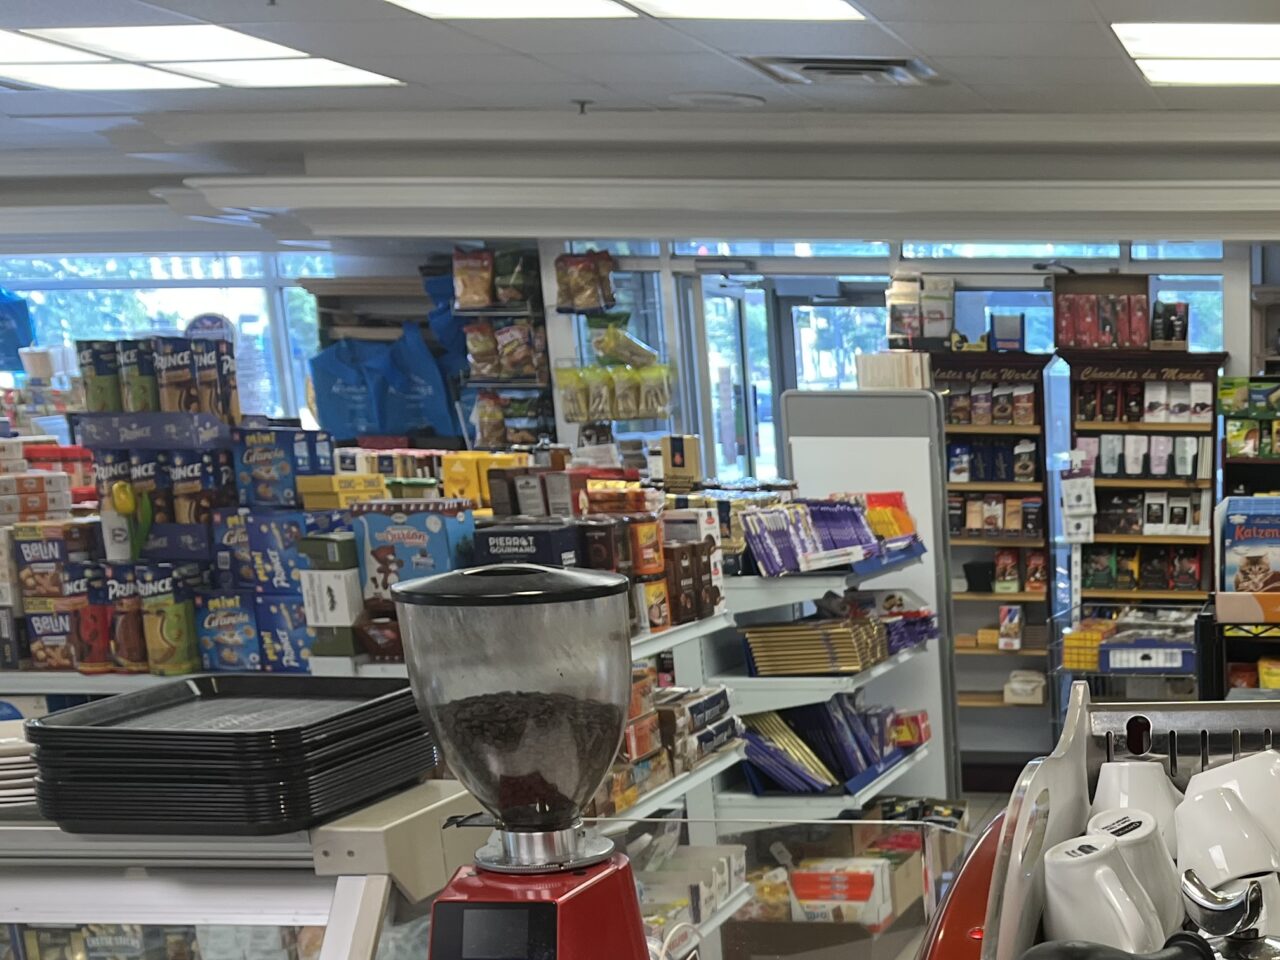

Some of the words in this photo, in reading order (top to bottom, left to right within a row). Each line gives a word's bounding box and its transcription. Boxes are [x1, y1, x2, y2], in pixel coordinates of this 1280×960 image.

[966, 369, 978, 381] of
[980, 369, 998, 380] the
[1001, 369, 1040, 380] World
[1080, 367, 1140, 380] Chocolats
[1141, 369, 1157, 380] du
[1161, 368, 1205, 380] Monde
[489, 536, 534, 546] PIERROT
